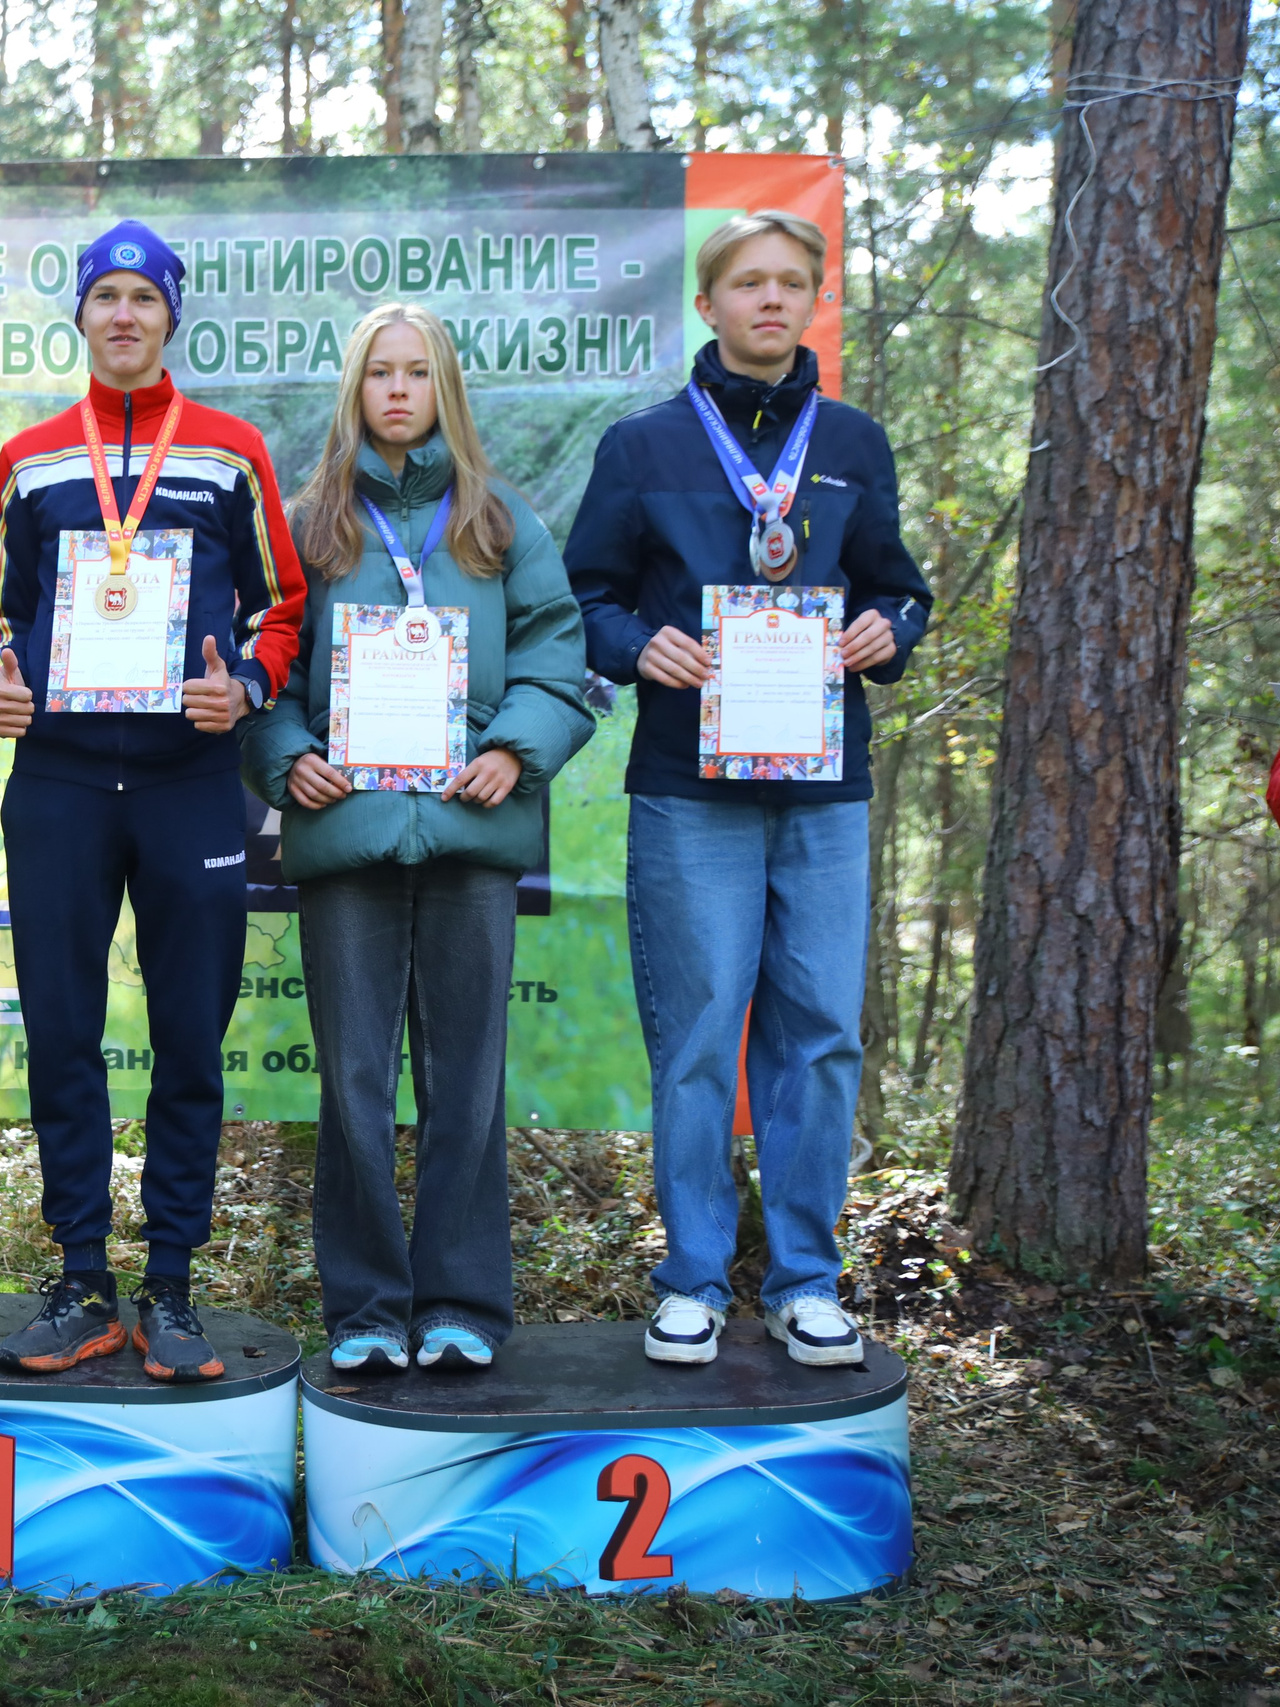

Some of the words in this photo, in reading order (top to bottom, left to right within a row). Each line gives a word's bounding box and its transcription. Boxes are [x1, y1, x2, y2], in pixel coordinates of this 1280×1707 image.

[29, 235, 599, 297] ОНТИРОВАНИЕ
[186, 317, 348, 377] ОБРА
[444, 314, 654, 374] ЖИЗНИ
[84, 408, 97, 443] ОБЛАСТЬ
[92, 444, 111, 505] ЧЕЛЯБИНСКАЯ
[138, 464, 157, 503] ОБЛАСТЬ
[155, 486, 215, 504] КОМАНДА74
[85, 572, 160, 586] ГРОТА
[732, 631, 812, 644] ГРАМОТА
[204, 850, 246, 868] КОМАНДА
[597, 1453, 673, 1581] 2
